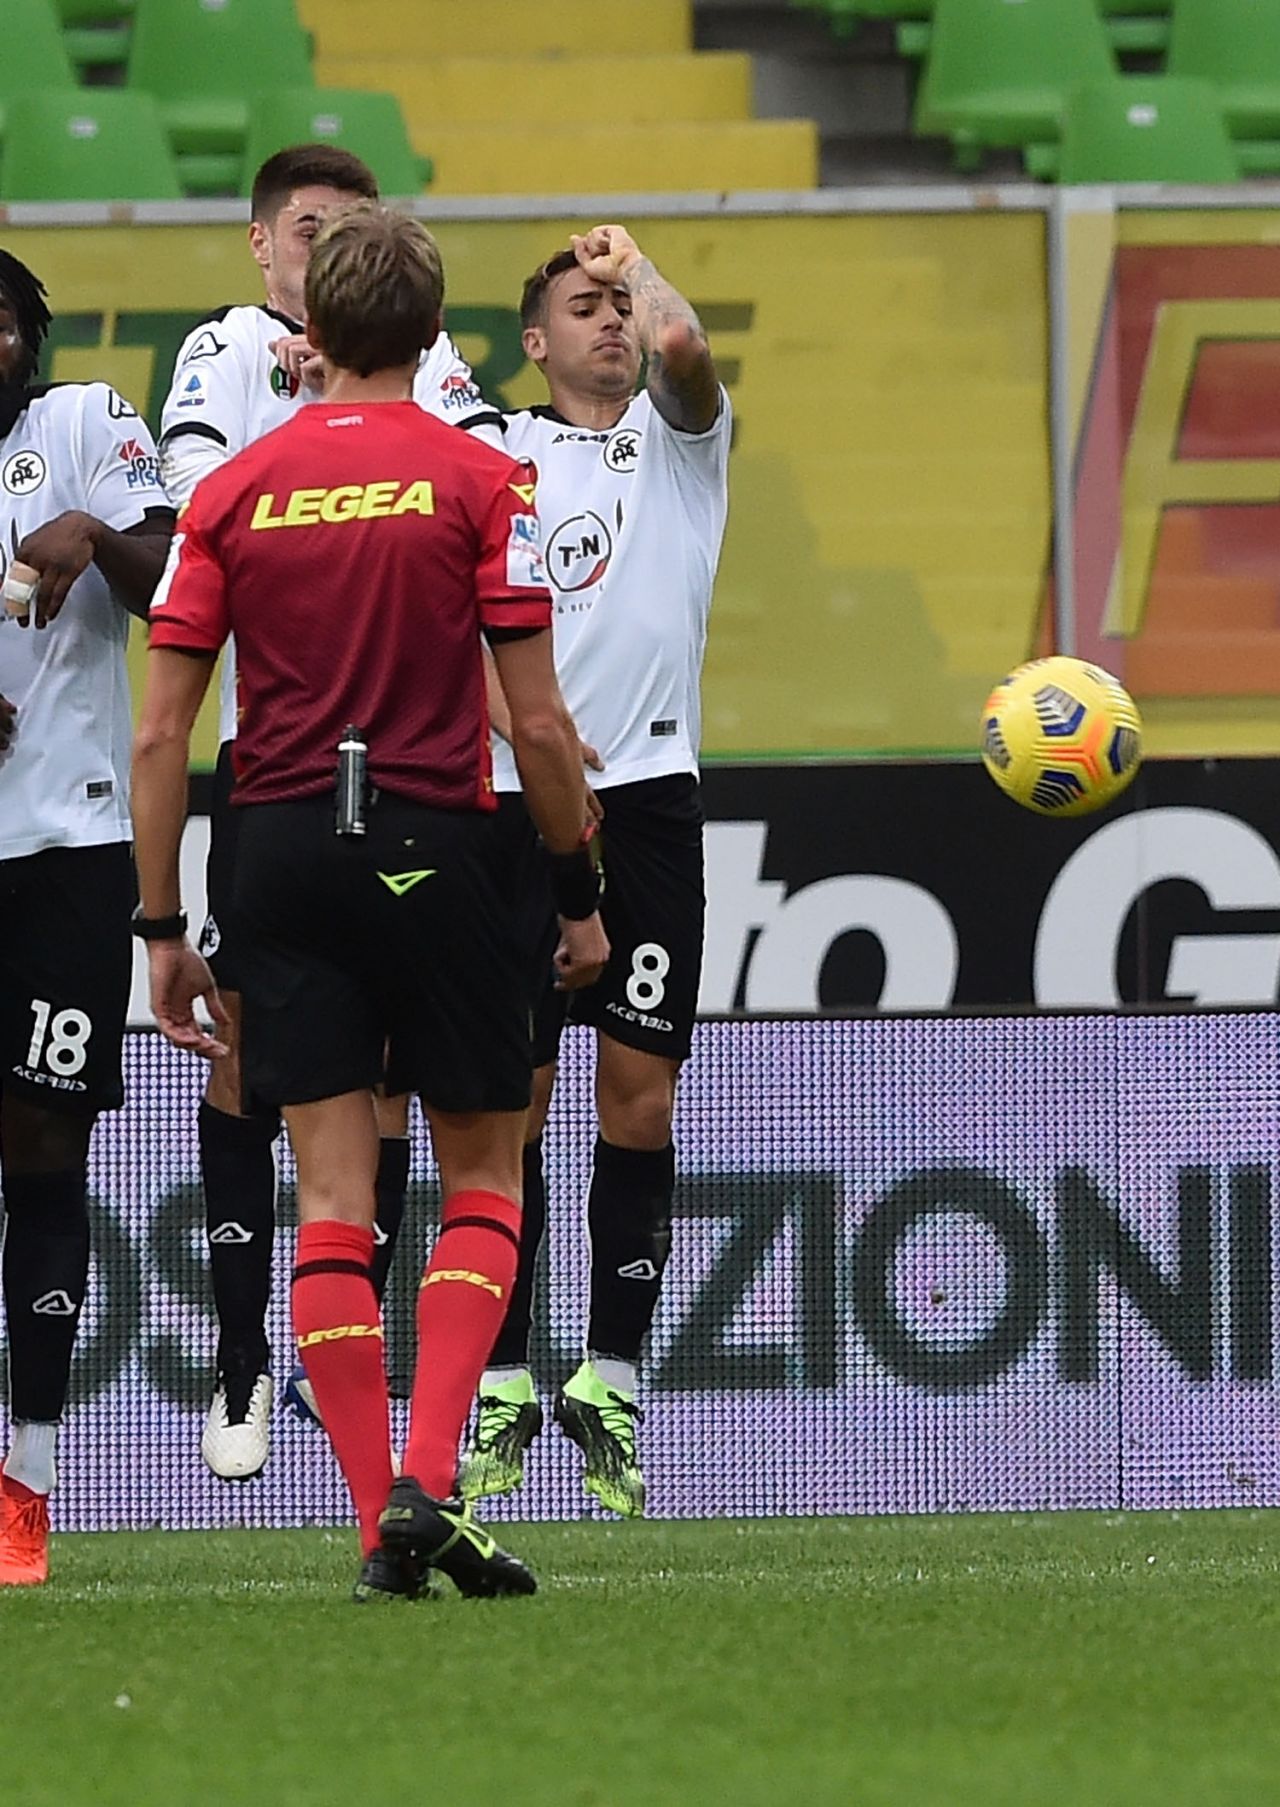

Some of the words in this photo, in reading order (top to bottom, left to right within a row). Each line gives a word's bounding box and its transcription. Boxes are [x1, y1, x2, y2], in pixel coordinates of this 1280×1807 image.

[250, 480, 435, 531] LEGEA
[625, 942, 670, 1011] 8
[26, 998, 93, 1077] 18
[419, 1269, 503, 1299] LEGEA
[297, 1324, 384, 1348] LEGEA
